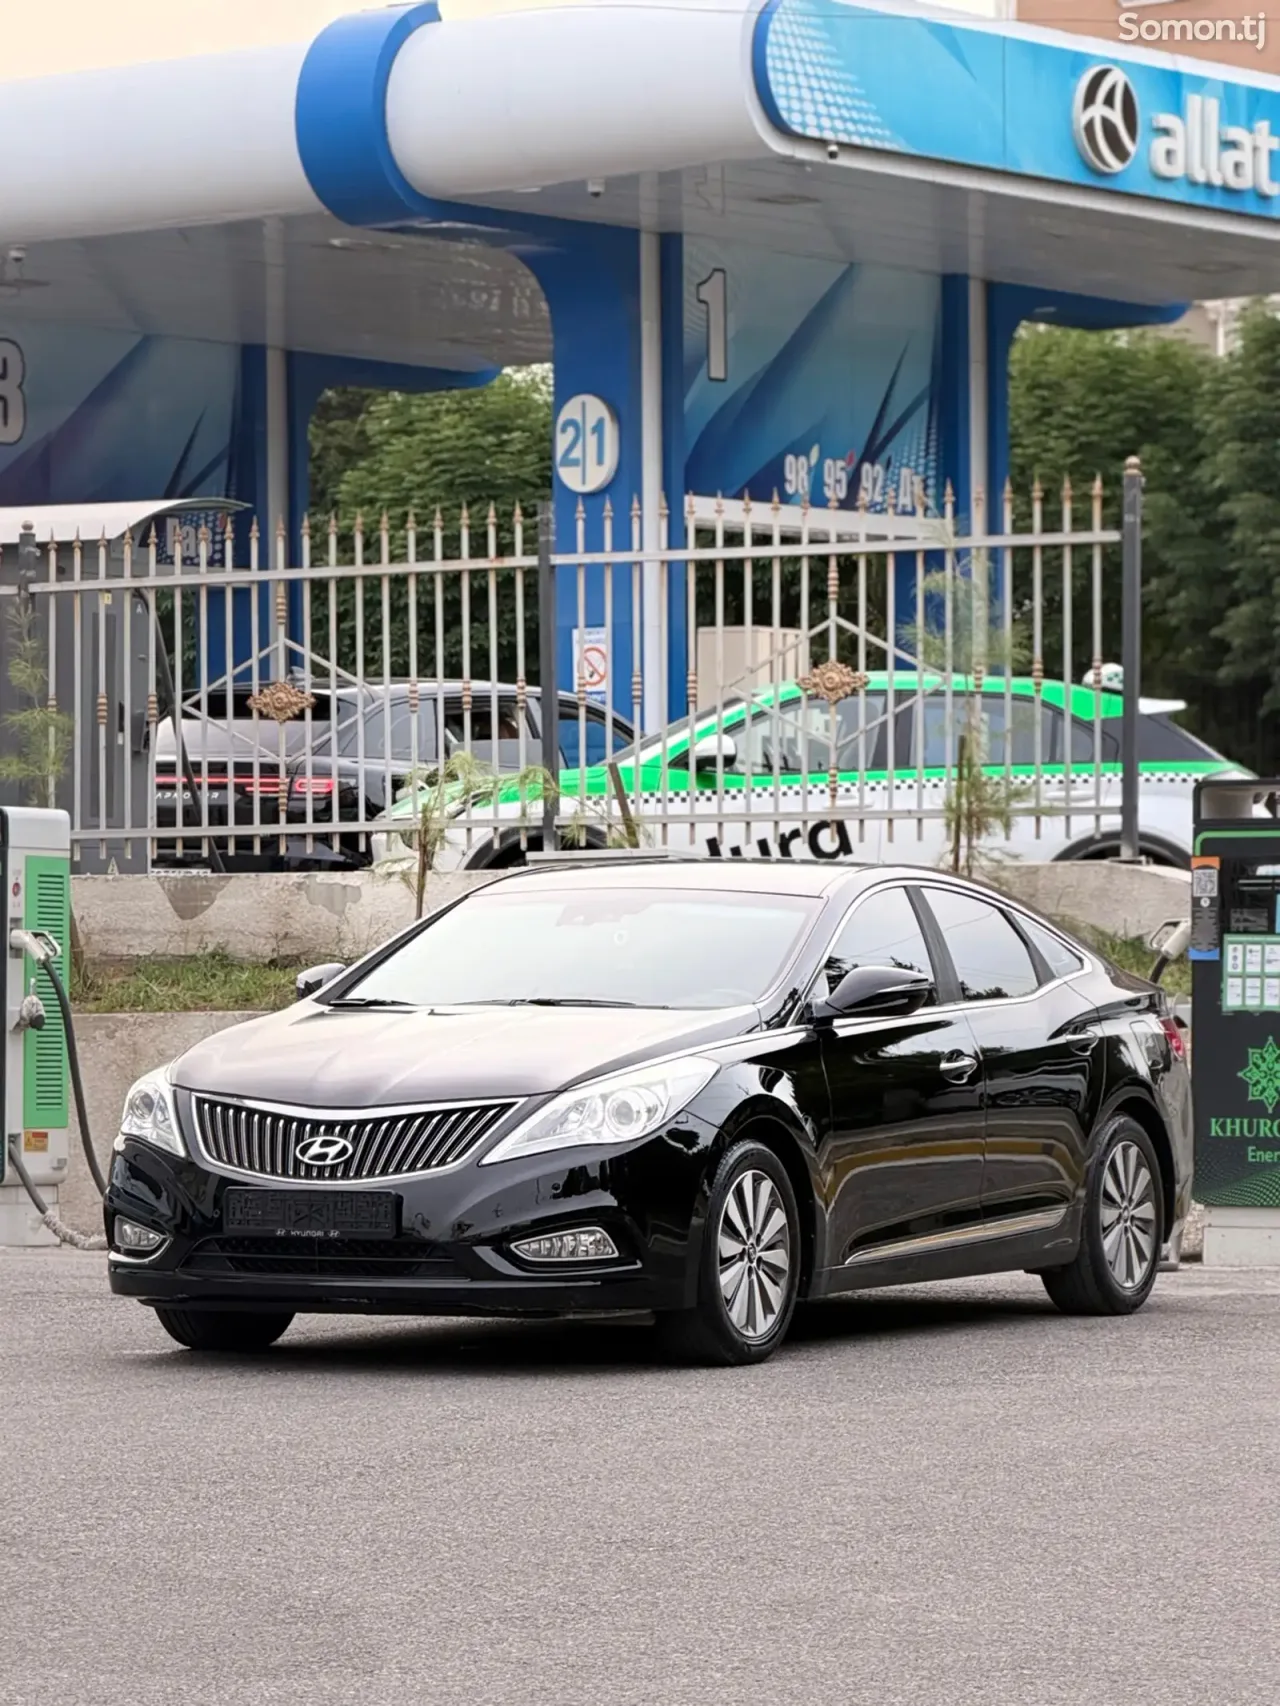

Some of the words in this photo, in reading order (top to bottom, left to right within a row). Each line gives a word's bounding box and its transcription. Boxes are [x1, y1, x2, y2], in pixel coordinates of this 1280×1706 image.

[1151, 93, 1280, 196] allat
[696, 267, 727, 382] 1
[784, 454, 808, 495] 98
[823, 458, 847, 500] 95
[860, 461, 883, 502] 92
